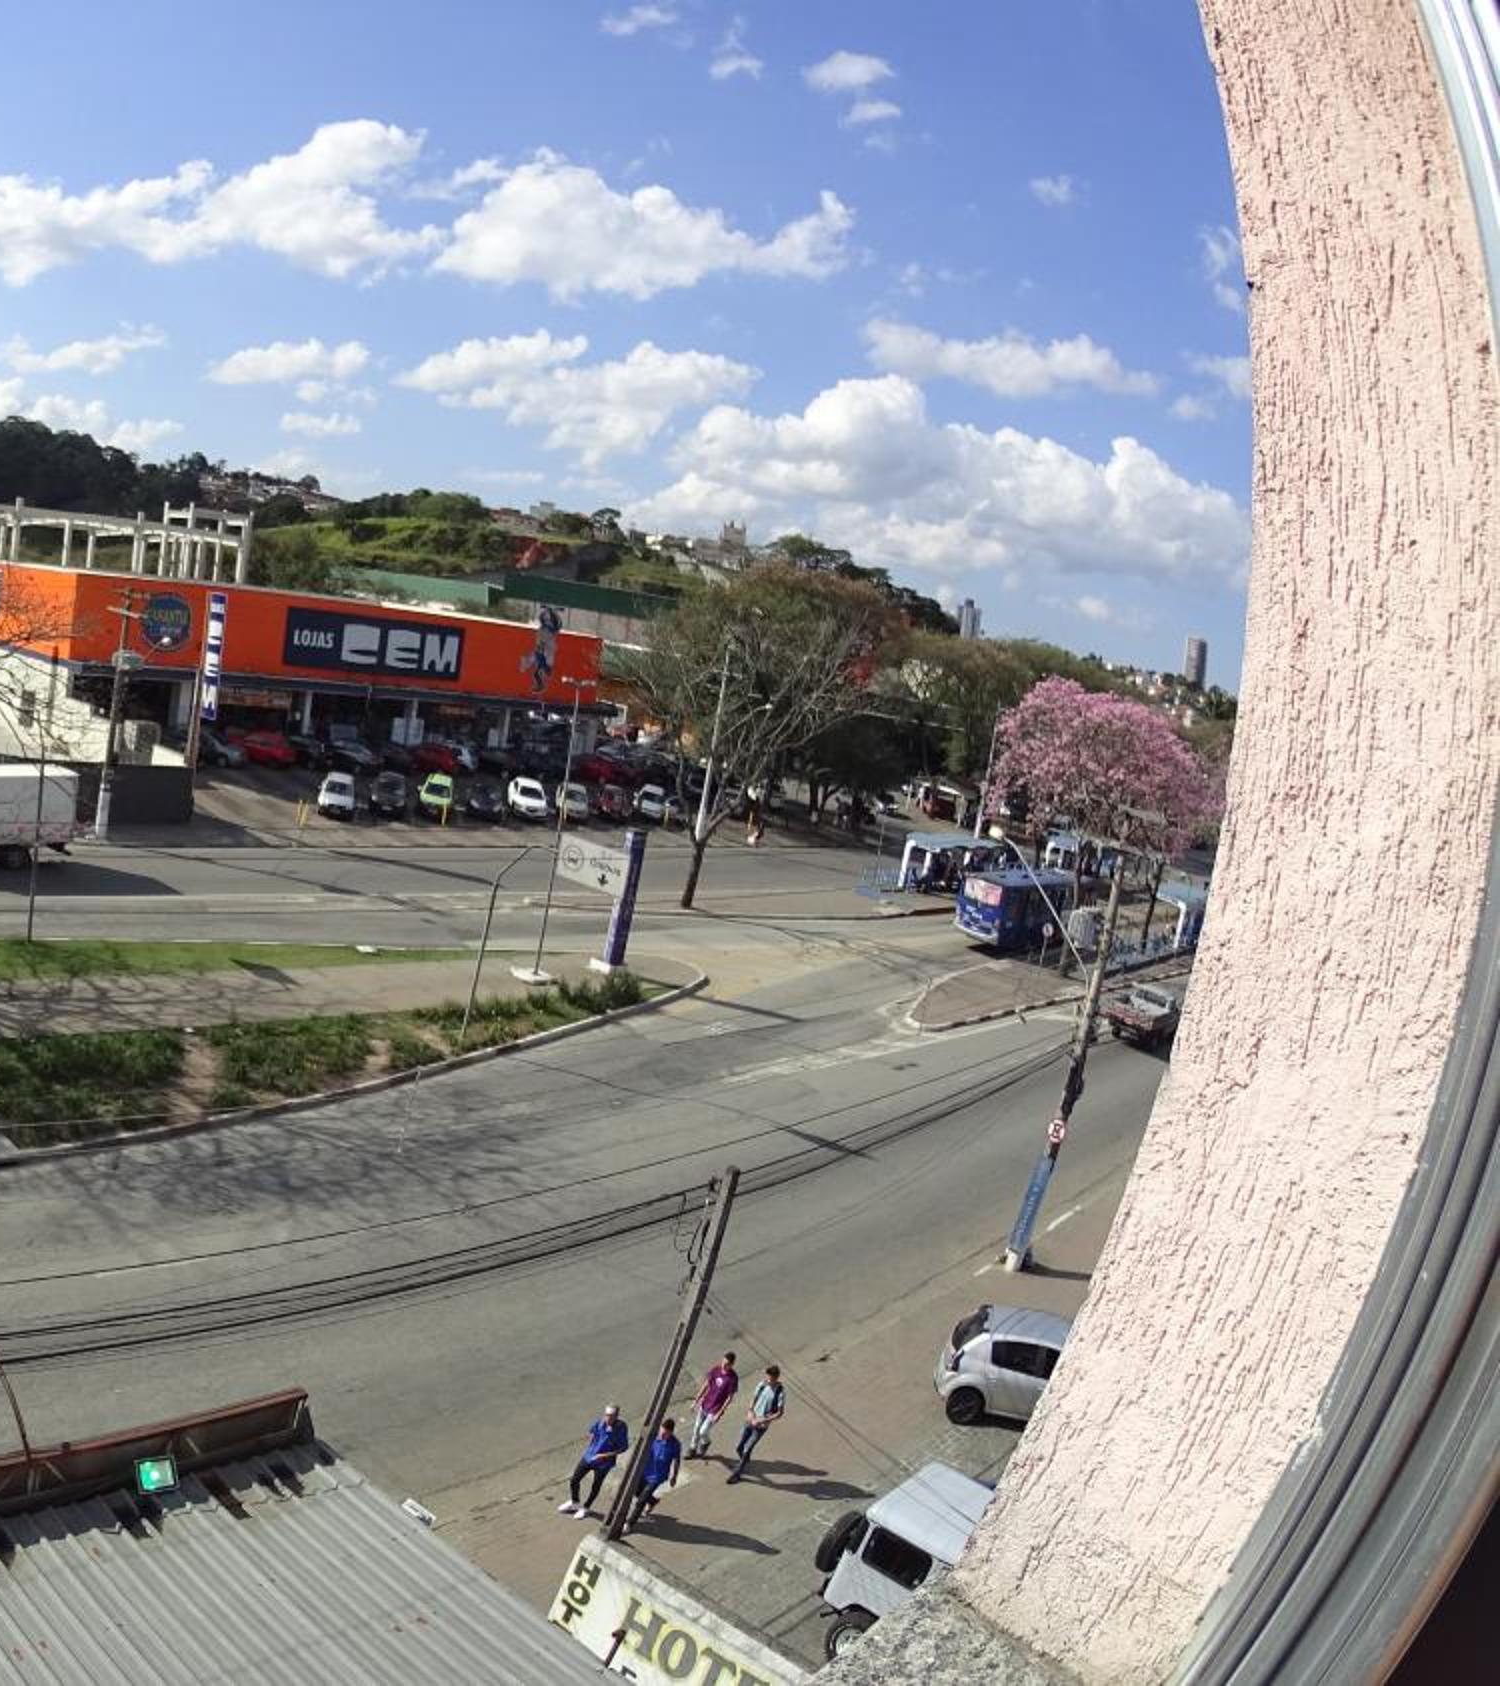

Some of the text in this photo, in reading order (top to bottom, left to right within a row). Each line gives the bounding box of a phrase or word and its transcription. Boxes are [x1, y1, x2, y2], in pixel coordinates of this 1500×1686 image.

[293, 623, 460, 673] LOJAS CEM
[548, 1554, 602, 1635] HOT
